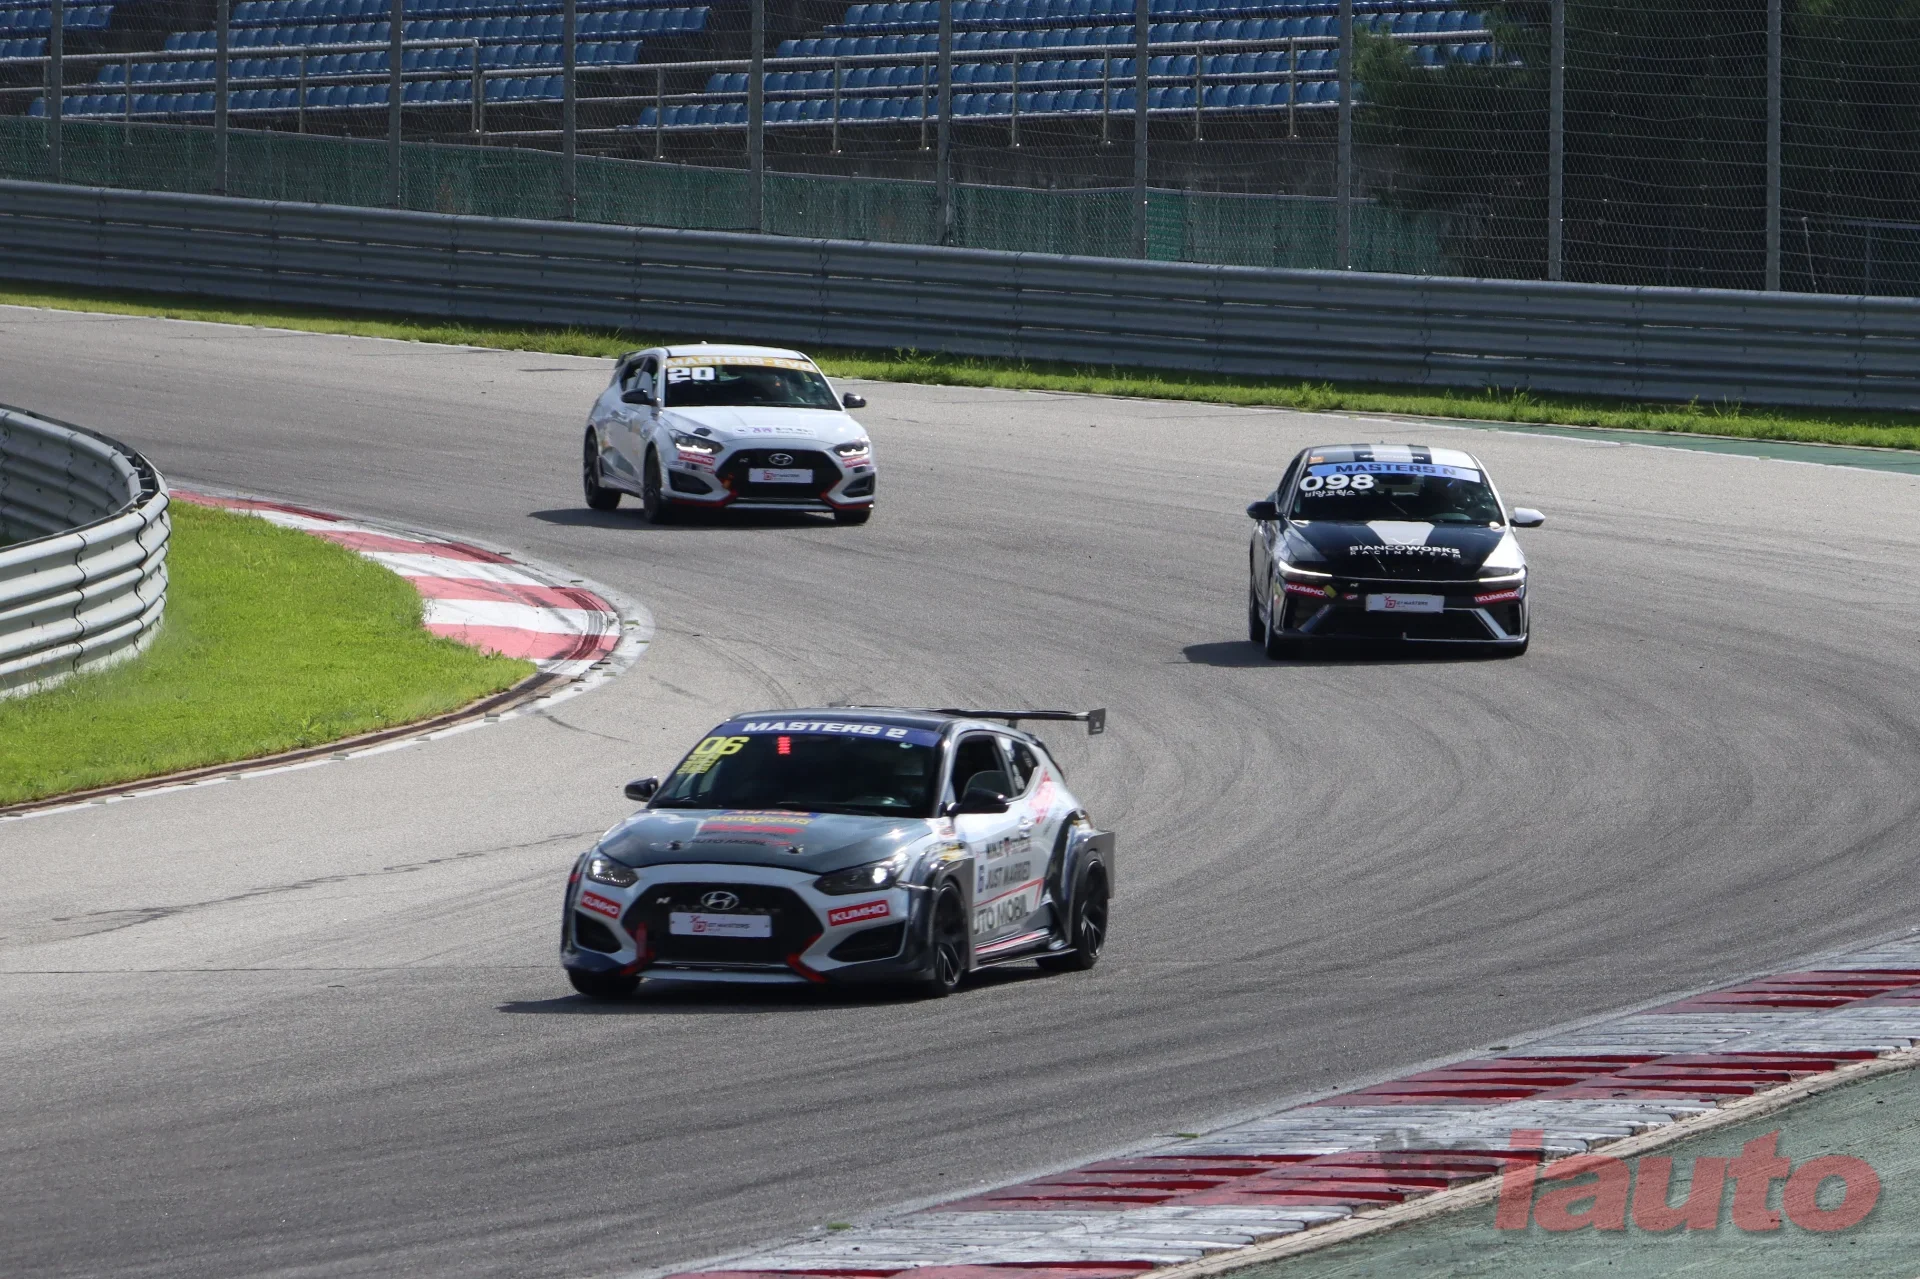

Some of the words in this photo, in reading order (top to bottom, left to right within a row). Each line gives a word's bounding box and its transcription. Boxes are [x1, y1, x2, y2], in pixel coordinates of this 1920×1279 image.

[667, 367, 715, 381] 20
[1336, 463, 1436, 474] MASTERS
[1442, 467, 1456, 476] N
[1299, 473, 1375, 491] 098
[1349, 544, 1461, 555] BIANCOWORKS
[742, 721, 883, 736] MASTERS
[885, 727, 908, 739] 2
[693, 736, 751, 756] 06
[582, 896, 620, 915] KUMHO
[831, 902, 889, 922] KUMHO
